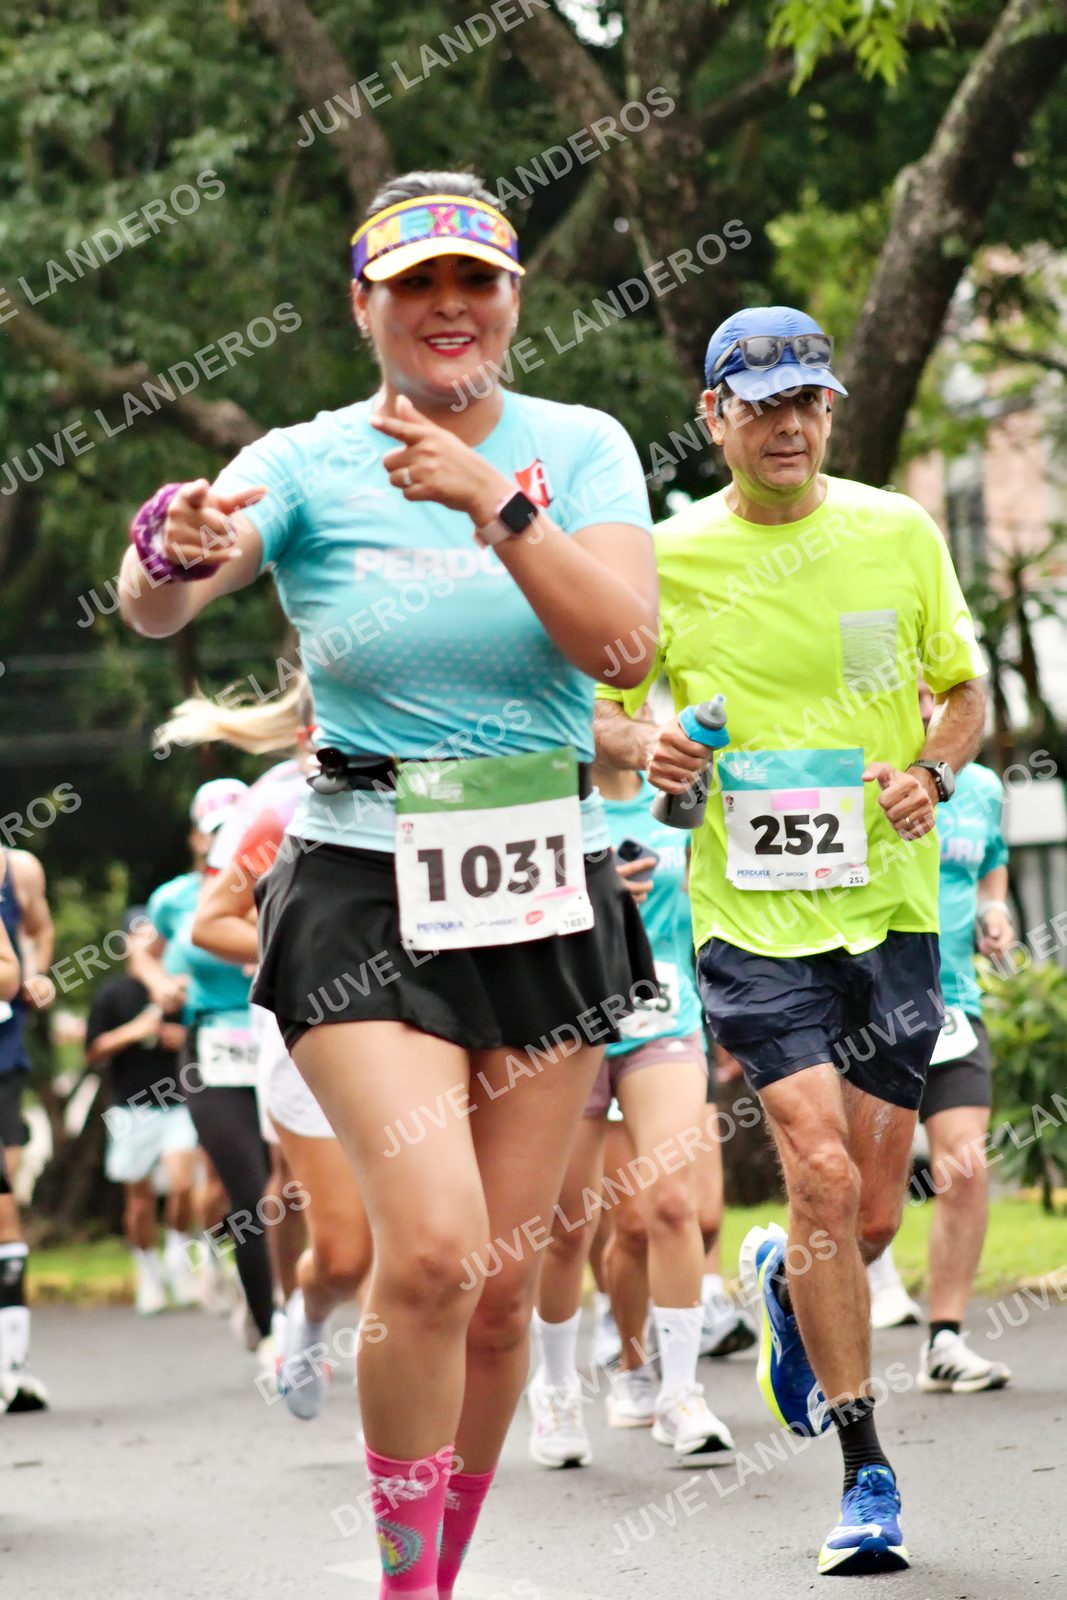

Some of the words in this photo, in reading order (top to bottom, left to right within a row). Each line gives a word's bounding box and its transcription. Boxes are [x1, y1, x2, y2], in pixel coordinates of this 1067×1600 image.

[366, 206, 513, 259] MEXICO
[354, 547, 507, 581] PERDU
[749, 813, 845, 856] 252
[416, 834, 568, 902] 1031
[848, 876, 865, 884] 252
